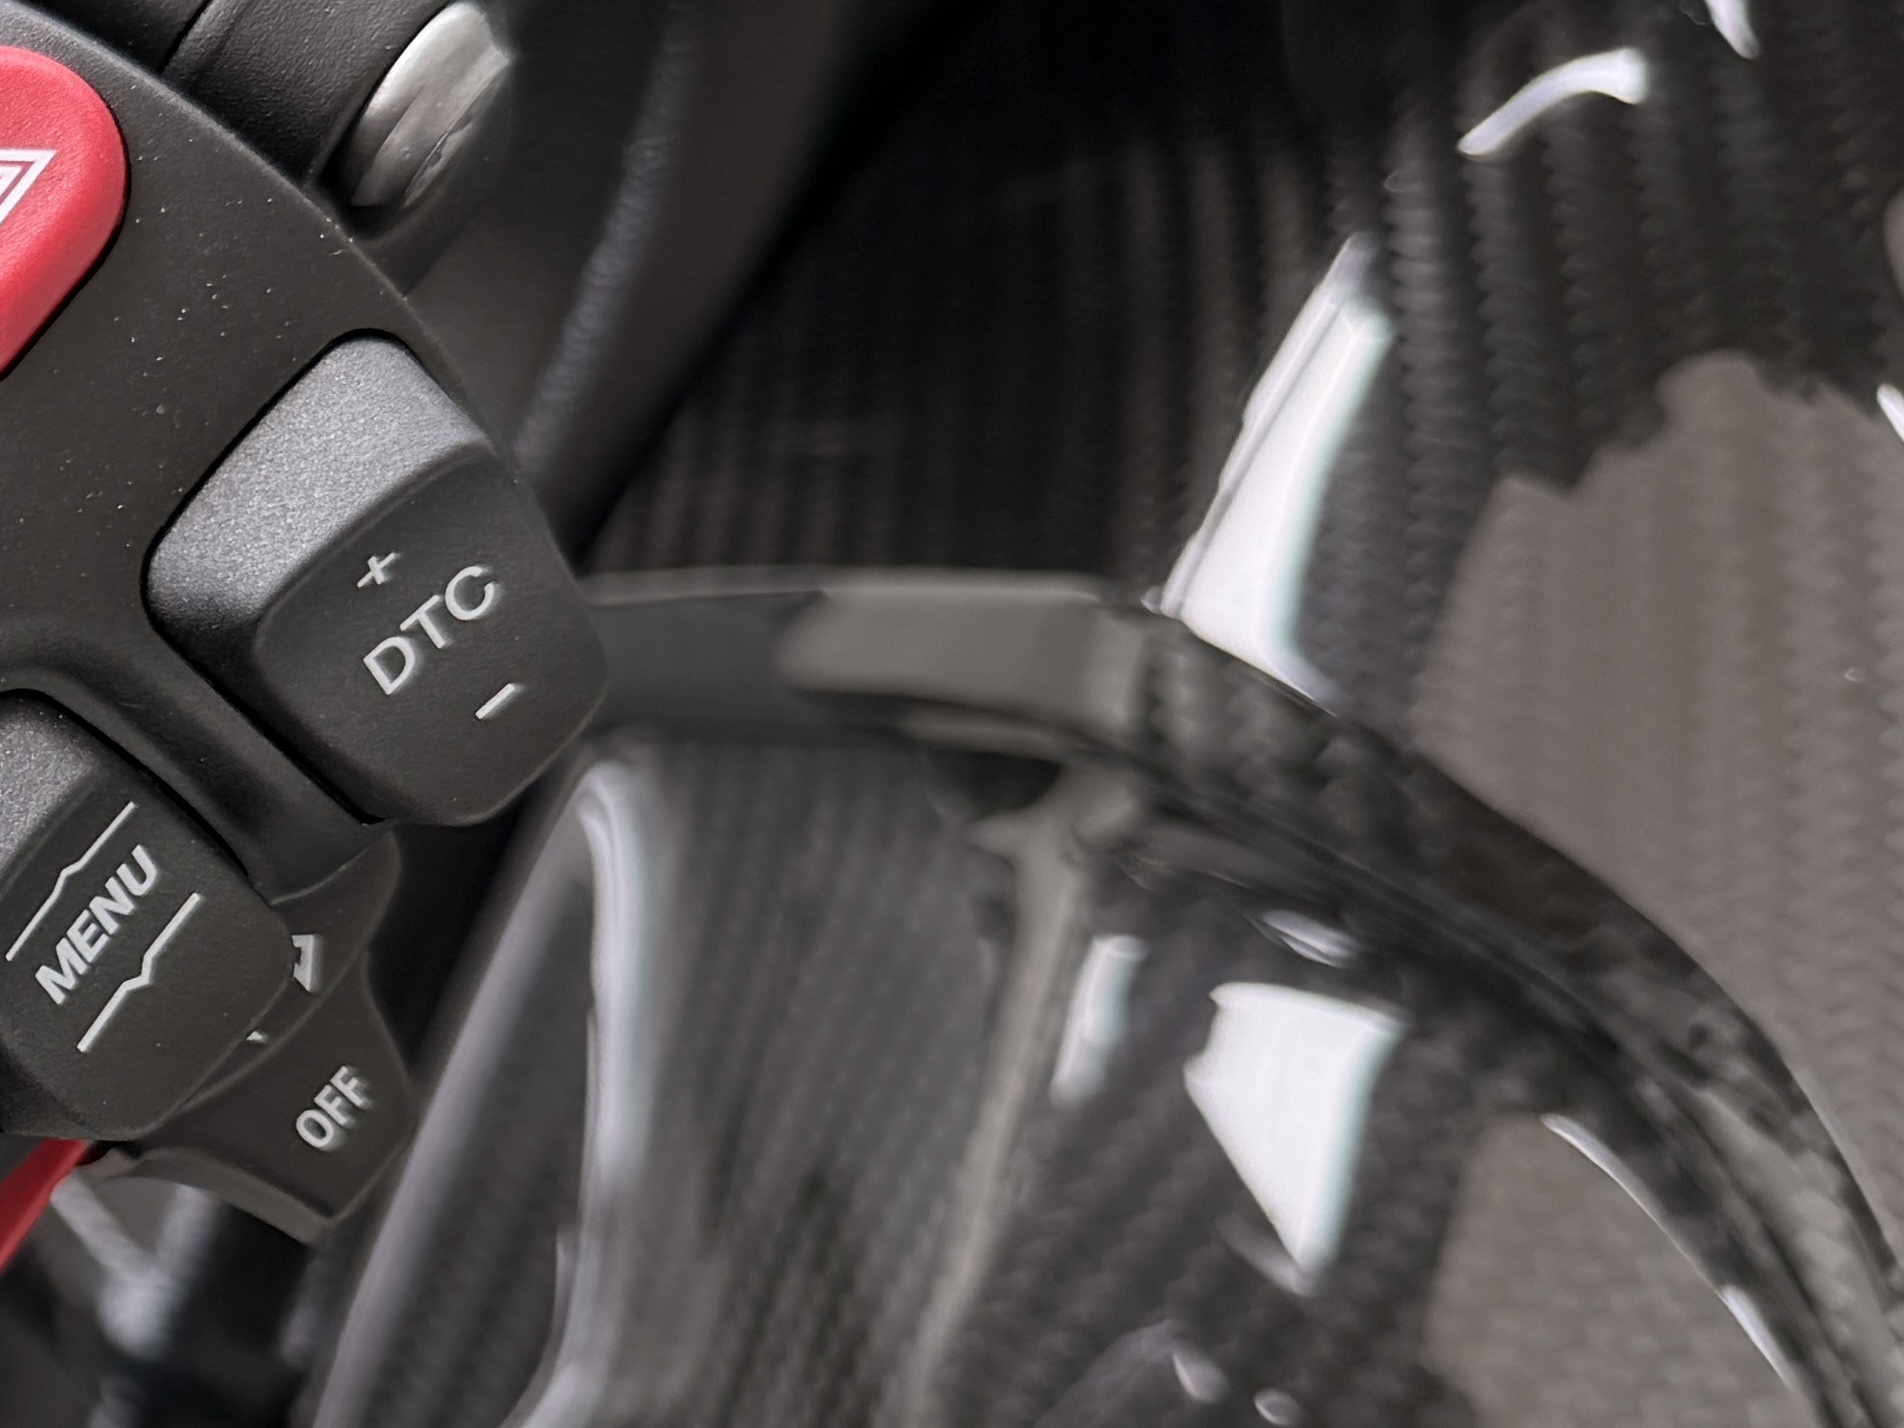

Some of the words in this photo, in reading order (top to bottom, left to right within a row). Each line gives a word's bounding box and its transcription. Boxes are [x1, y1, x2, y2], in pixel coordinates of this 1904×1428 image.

[363, 565, 495, 695] DTC
[34, 844, 158, 1005] MENU
[295, 1065, 371, 1150] OFF
